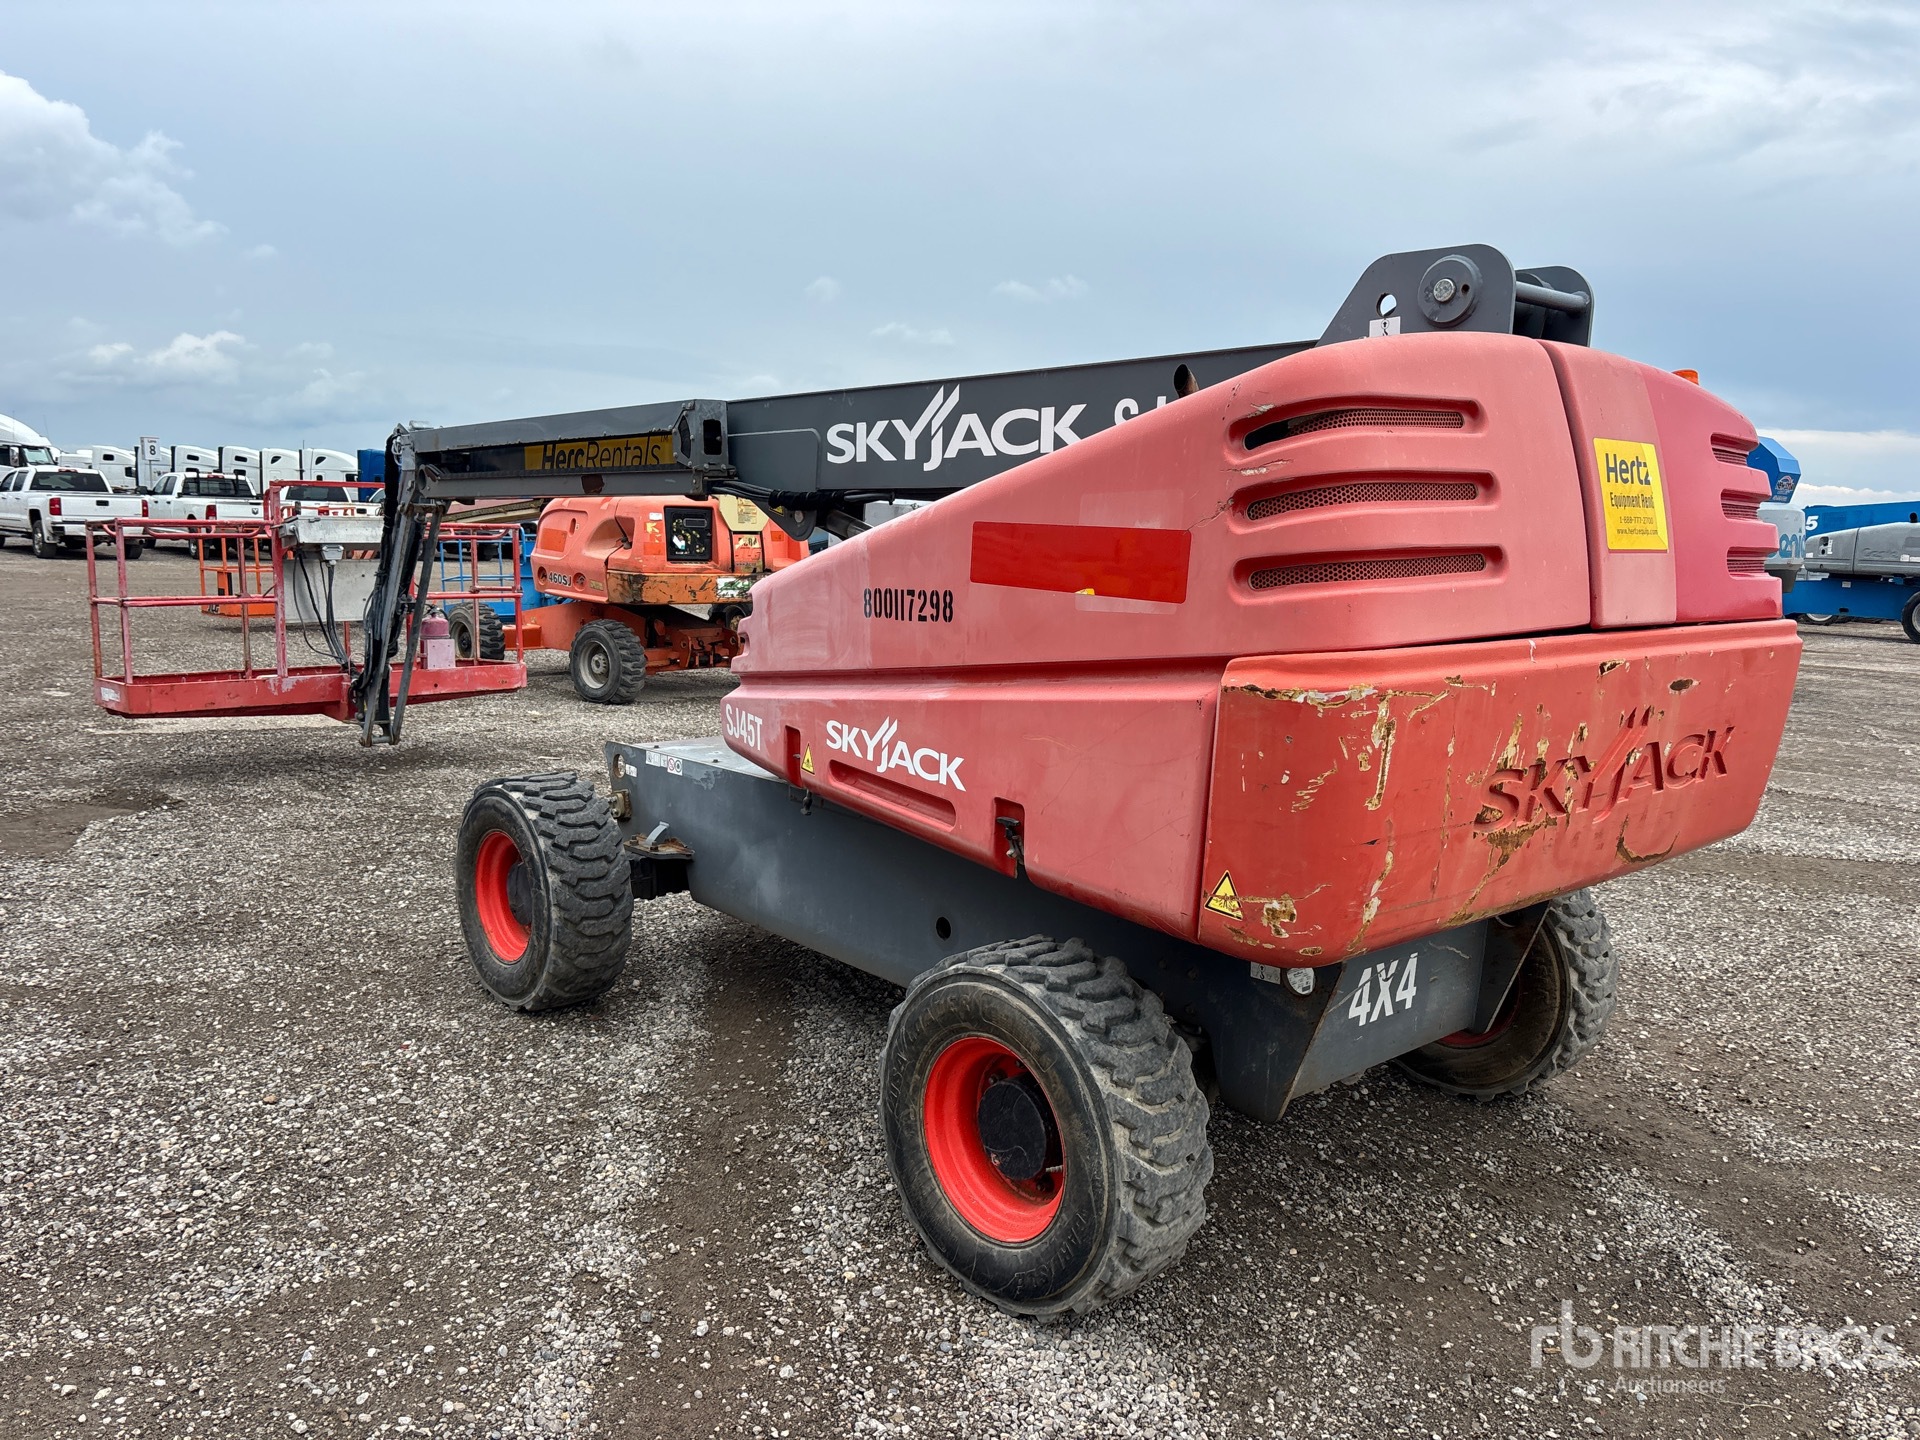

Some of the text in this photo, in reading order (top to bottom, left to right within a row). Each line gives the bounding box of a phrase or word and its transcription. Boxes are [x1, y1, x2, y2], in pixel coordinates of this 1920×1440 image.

[826, 384, 1087, 471] SKYJACK
[149, 445, 157, 456] 8
[541, 435, 661, 470] HercRentals
[1605, 452, 1651, 486] Hertz
[1610, 491, 1641, 510] Equipment
[548, 571, 572, 587] 460SJ
[863, 587, 954, 623] 800117298
[725, 703, 763, 751] SJ45T
[826, 715, 967, 792] SKYJACK
[1473, 705, 1735, 833] SKYJACK
[1348, 952, 1419, 1027] 4X4
